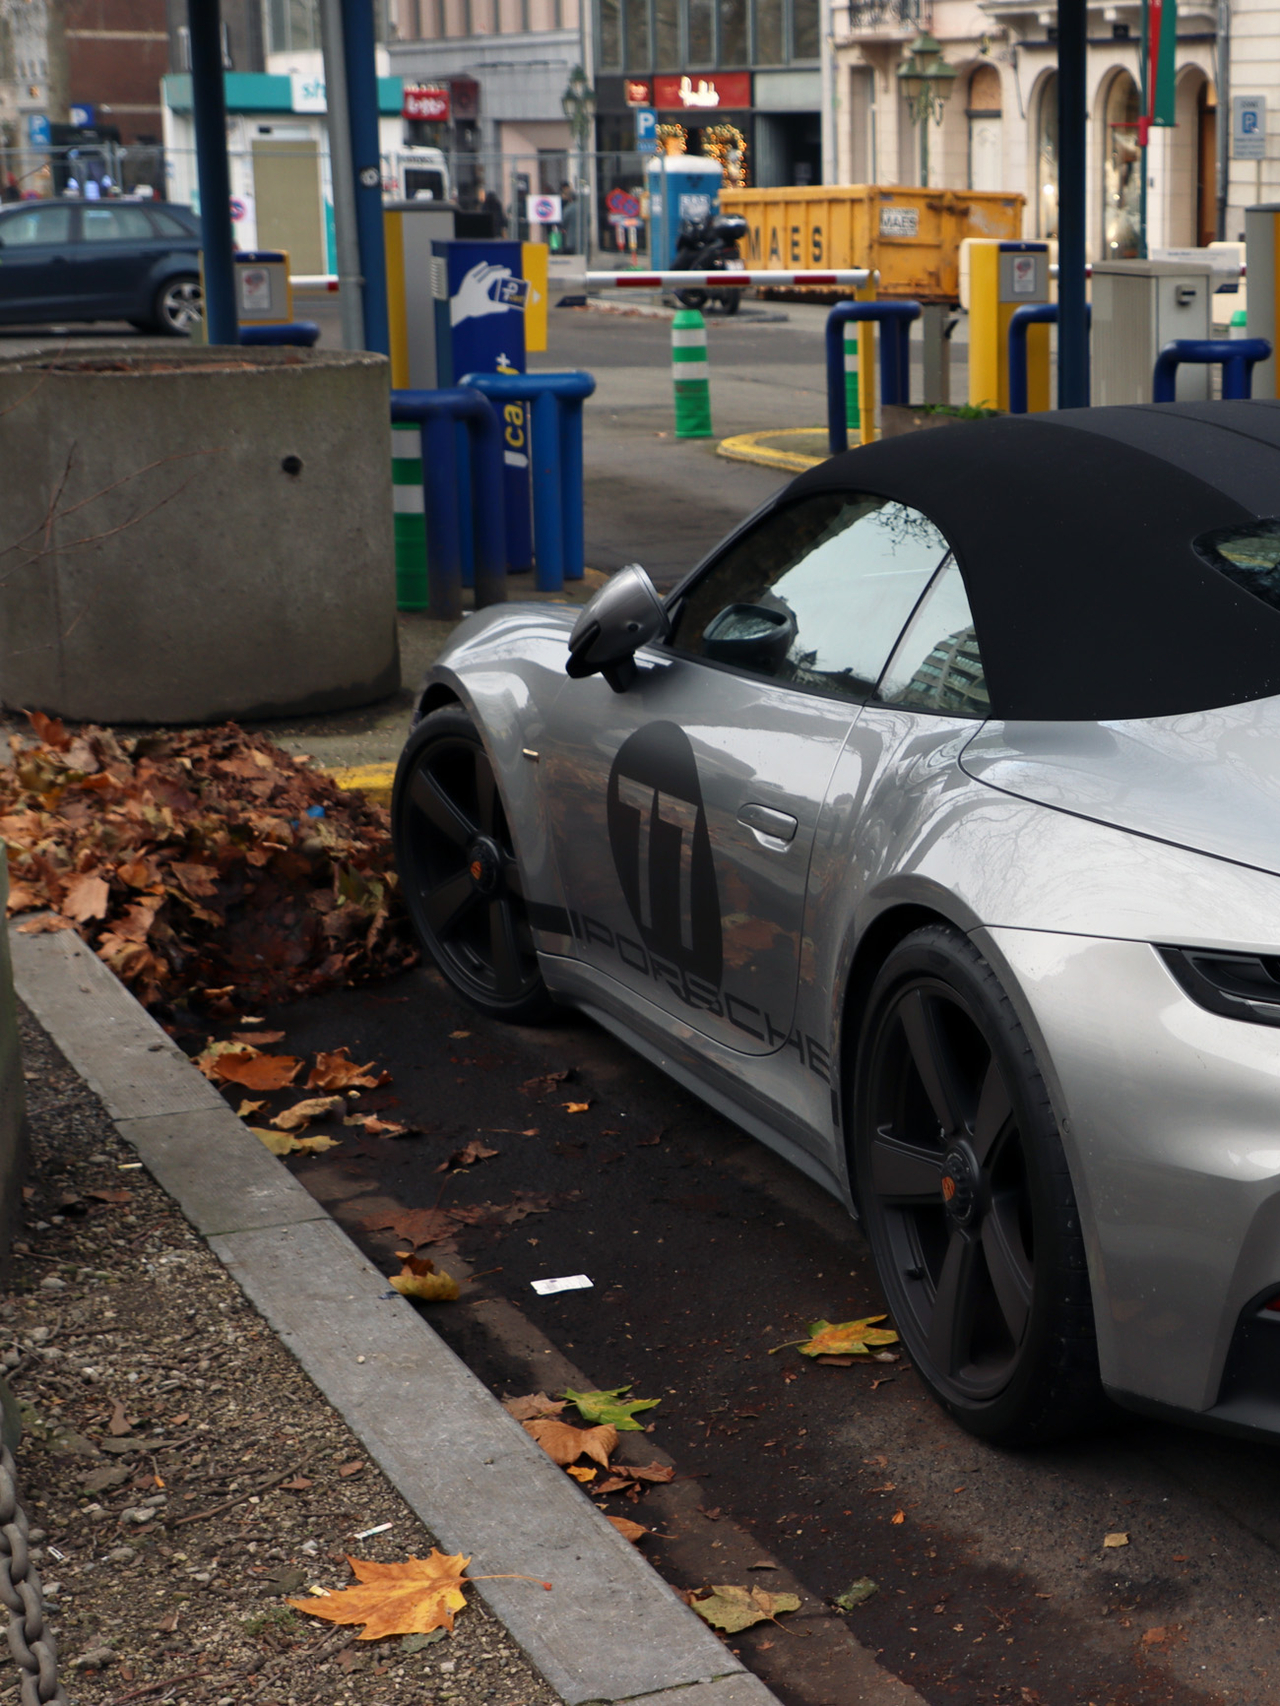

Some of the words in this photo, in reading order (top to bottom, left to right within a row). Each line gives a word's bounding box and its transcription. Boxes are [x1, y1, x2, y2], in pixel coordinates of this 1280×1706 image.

[640, 112, 655, 136] P
[747, 225, 823, 263] MAES
[579, 912, 832, 1086] PORSCHE
